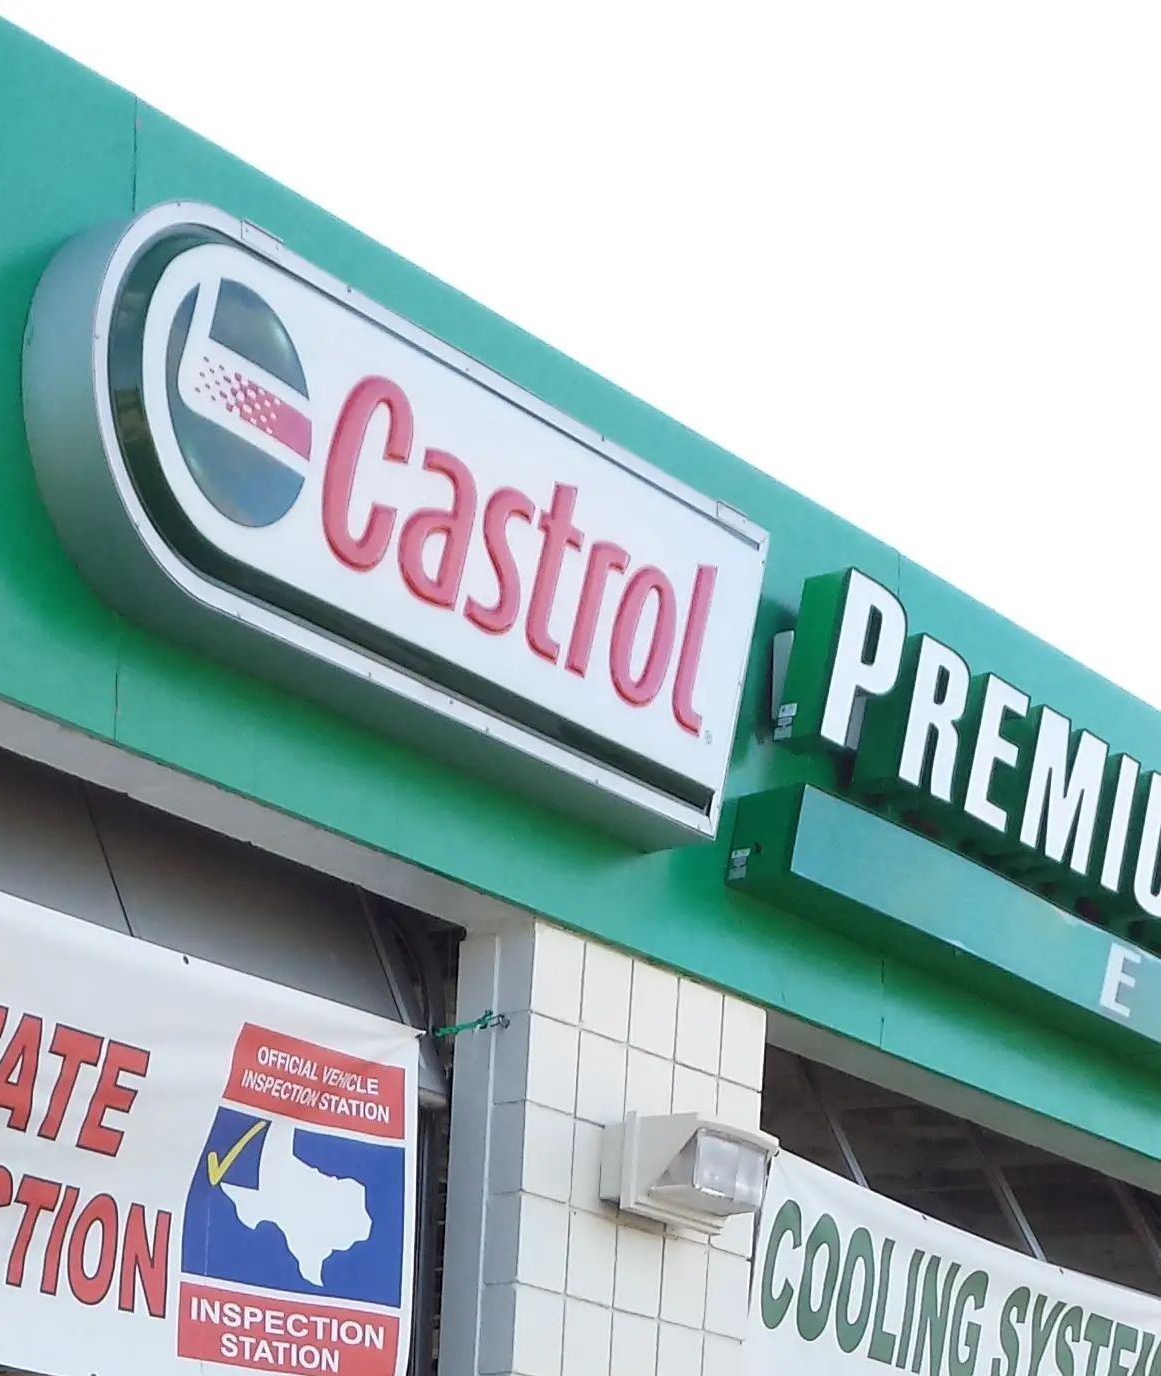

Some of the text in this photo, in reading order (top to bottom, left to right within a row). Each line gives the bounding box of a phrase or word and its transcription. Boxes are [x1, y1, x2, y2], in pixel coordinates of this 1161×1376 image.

[320, 375, 720, 738] Castrol
[241, 1069, 390, 1124] INSPECTION STATION
[257, 1046, 379, 1095] OFFICIAL VEHICLE
[191, 1297, 384, 1350] INSPECTION
[220, 1333, 339, 1373] STATION
